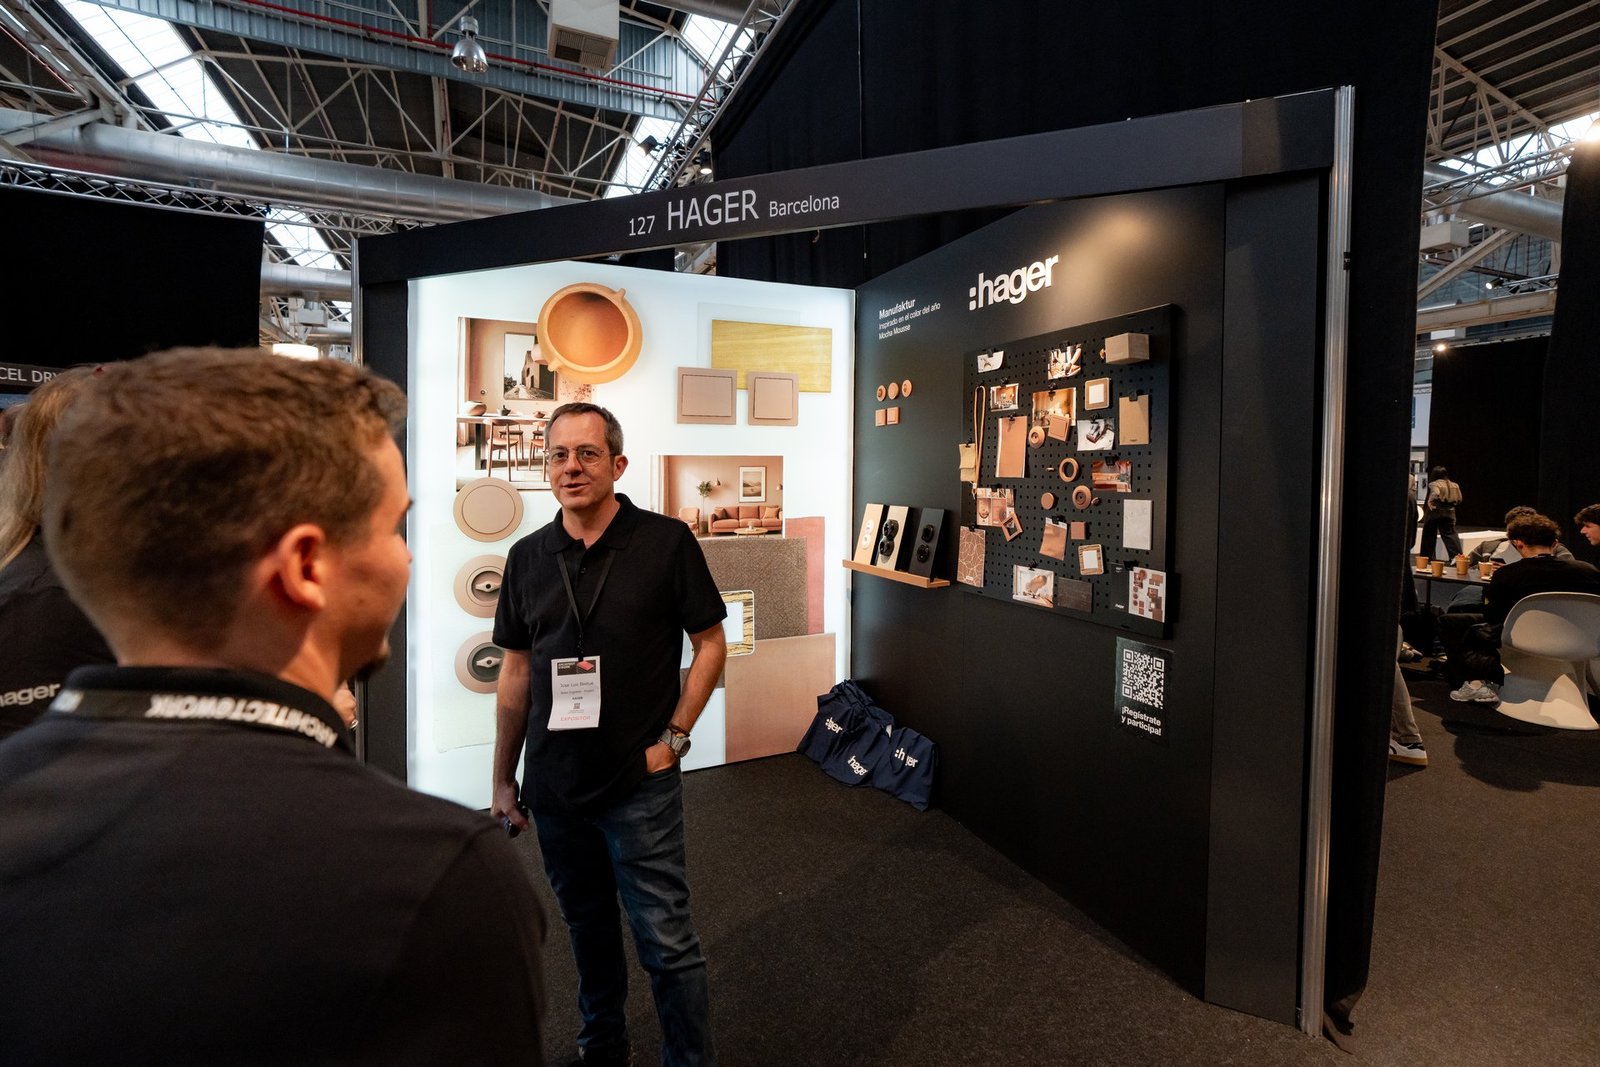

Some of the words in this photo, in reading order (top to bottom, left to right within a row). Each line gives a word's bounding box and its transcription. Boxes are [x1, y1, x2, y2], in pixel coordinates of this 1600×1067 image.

[628, 215, 656, 237] 127
[667, 189, 760, 231] HAGER
[769, 195, 840, 218] Barcelona
[879, 299, 915, 320] Manufaktur
[904, 313, 910, 321] el
[910, 309, 921, 319] color
[922, 305, 930, 315] del
[930, 302, 941, 312] año
[878, 330, 893, 341] Mocha
[893, 324, 911, 335] Mousse
[31, 370, 57, 383] DR
[1121, 715, 1126, 723] y
[1127, 717, 1162, 736] participa!
